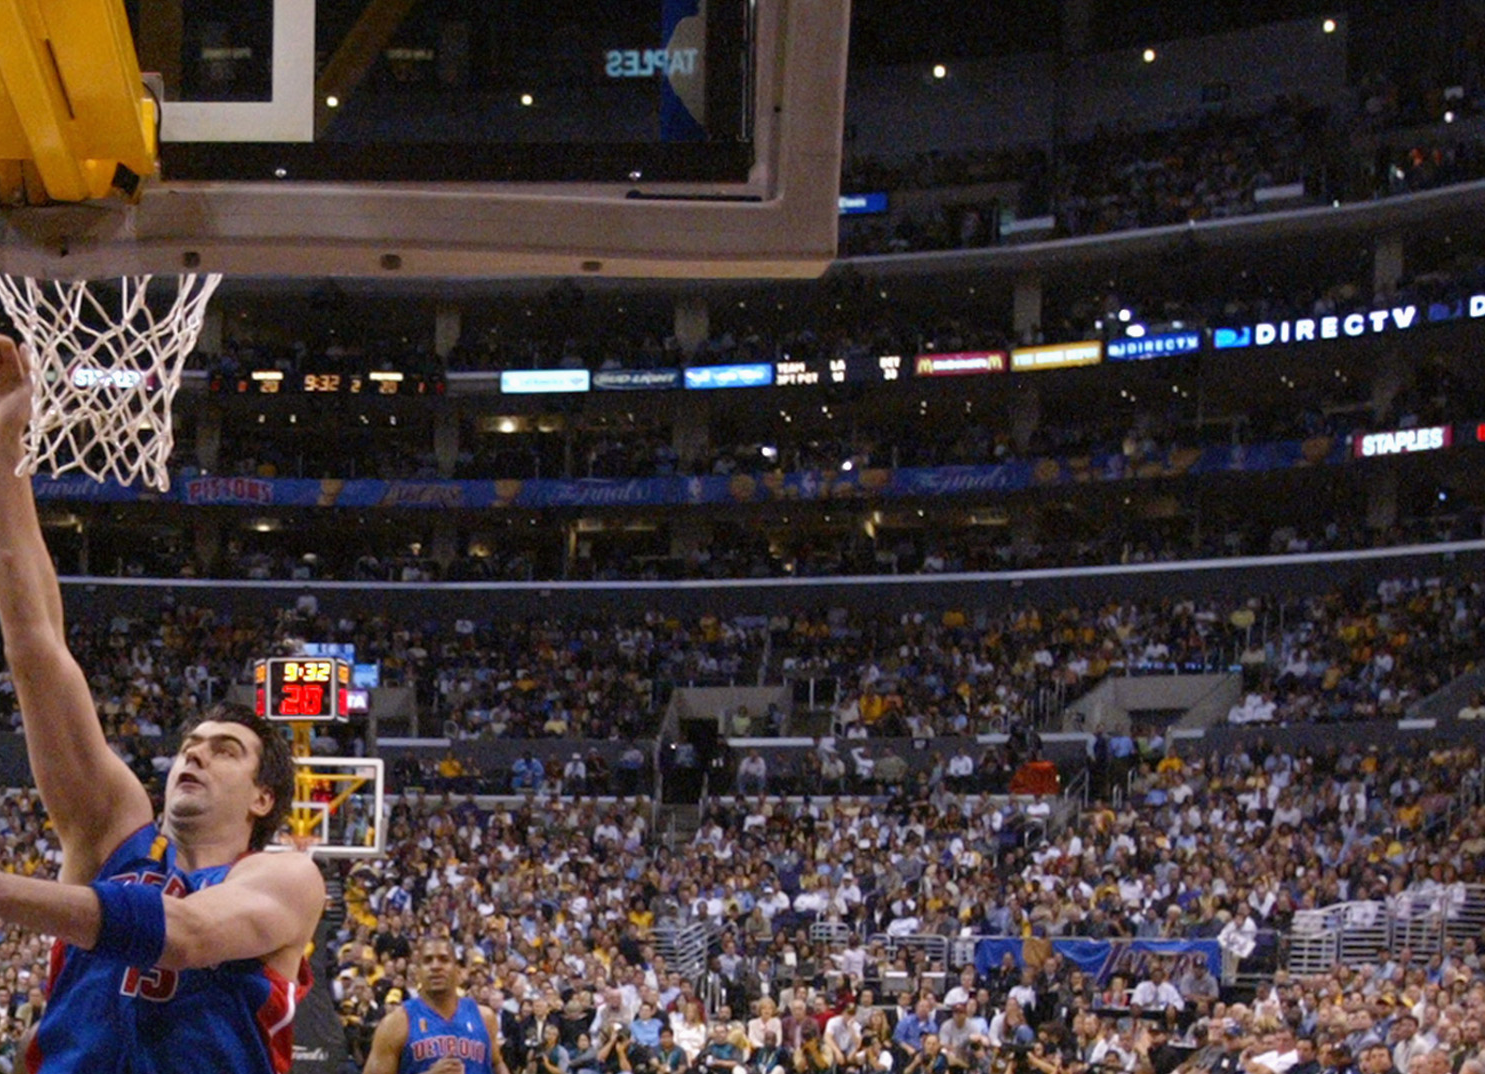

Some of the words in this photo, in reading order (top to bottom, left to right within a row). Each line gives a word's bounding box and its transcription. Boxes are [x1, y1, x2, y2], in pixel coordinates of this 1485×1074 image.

[1255, 305, 1416, 345] DIRECTV
[304, 374, 340, 391] 9:32
[1362, 426, 1444, 457] STAPLES
[283, 662, 331, 683] 9:32
[410, 1035, 487, 1065] DETROIT
